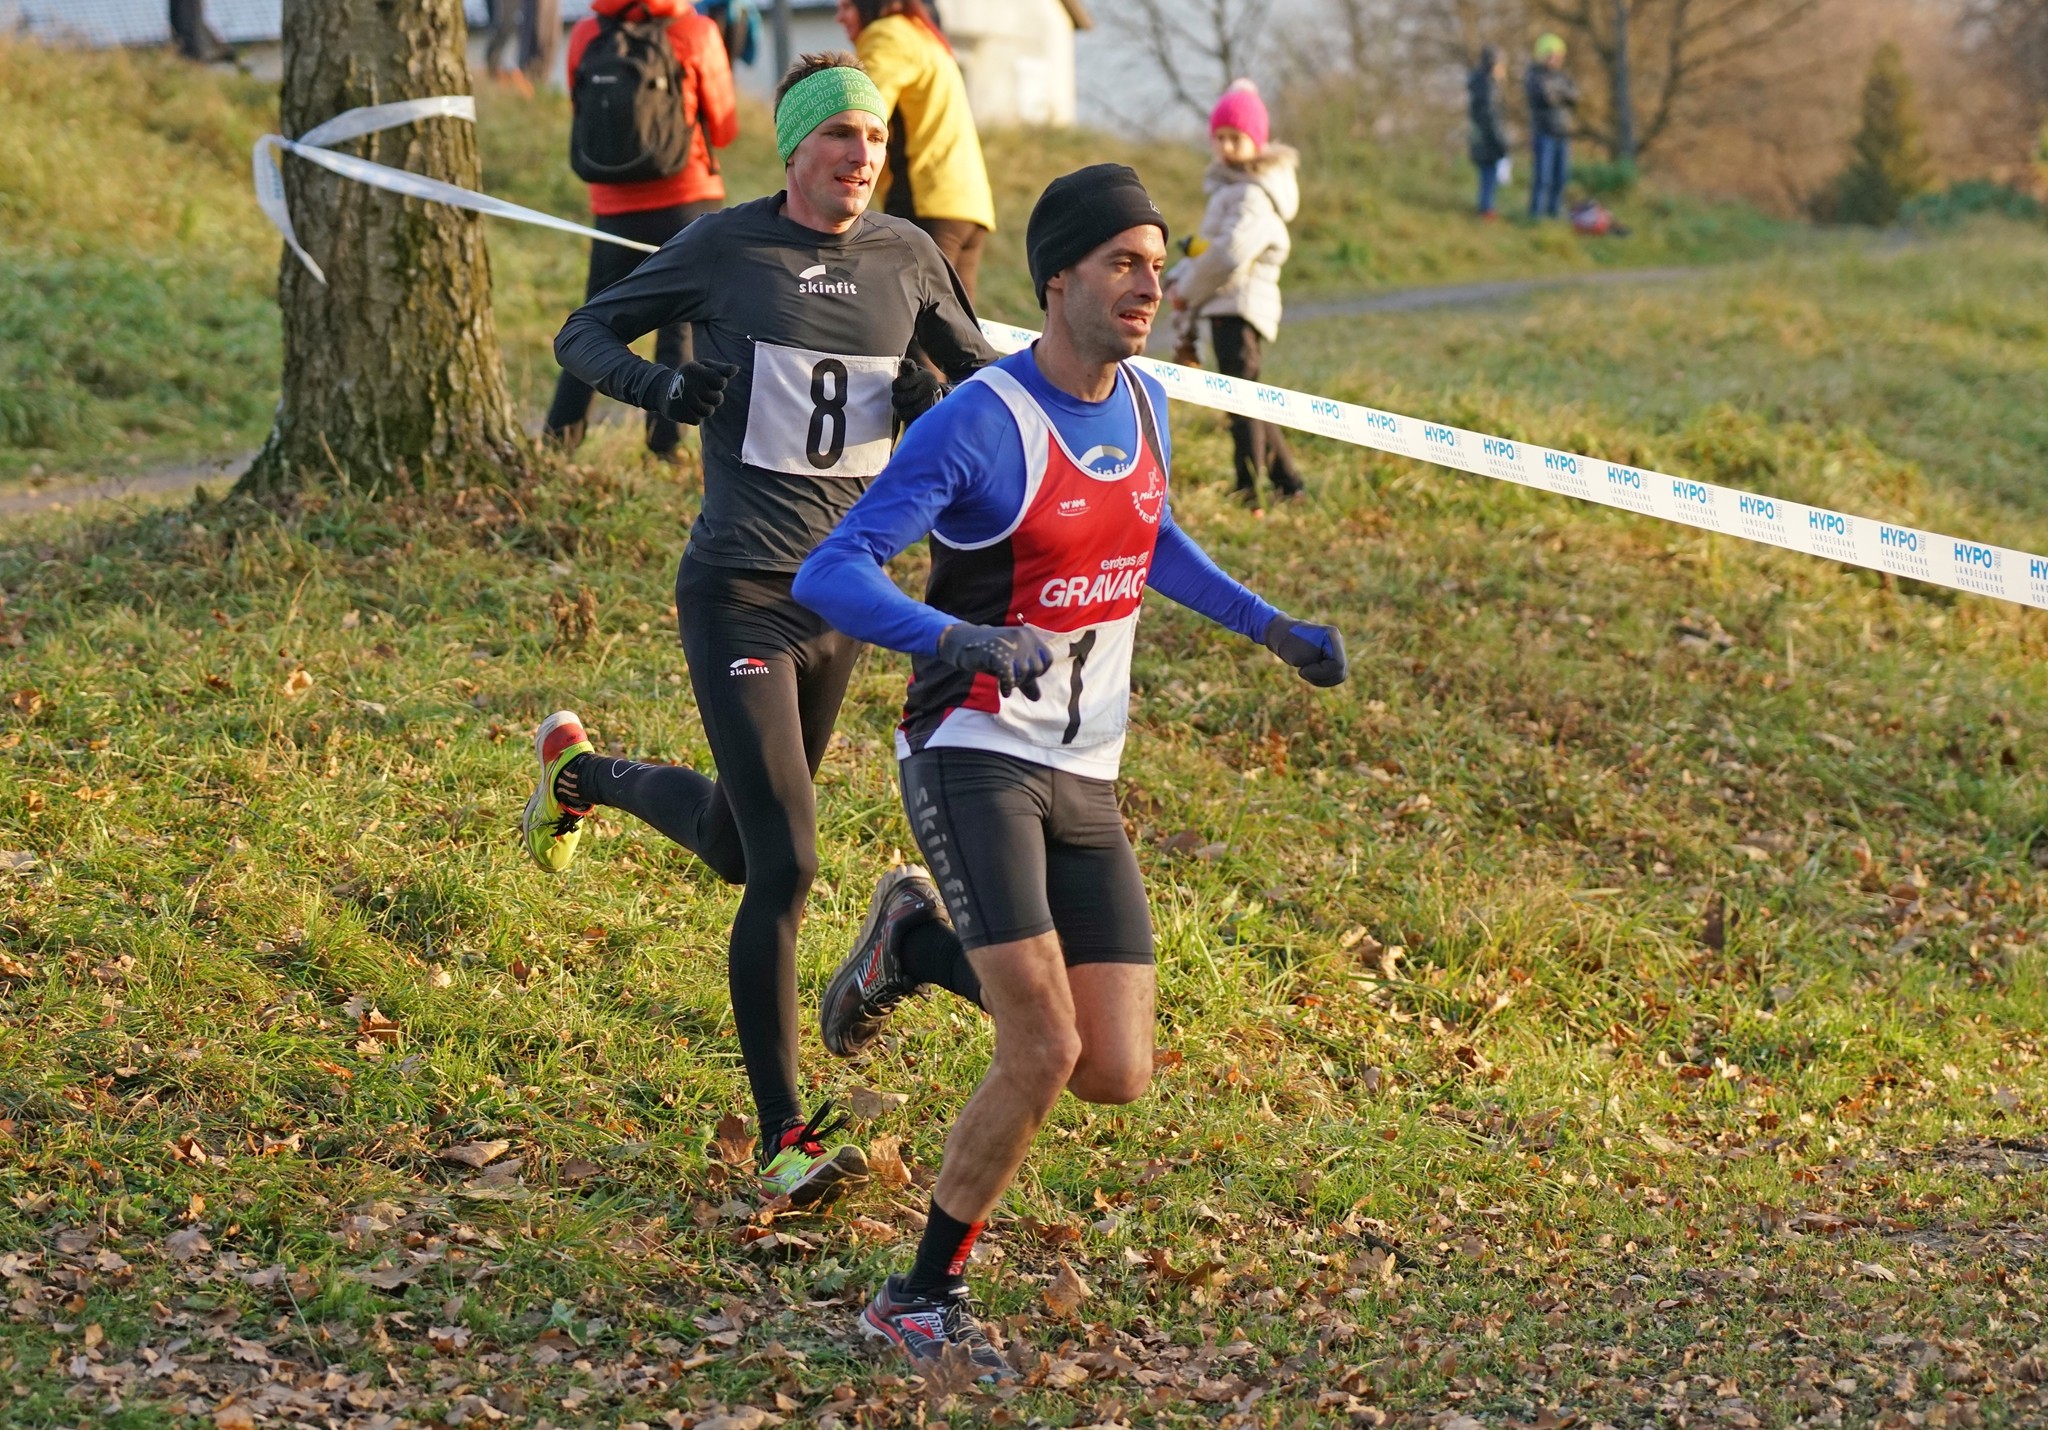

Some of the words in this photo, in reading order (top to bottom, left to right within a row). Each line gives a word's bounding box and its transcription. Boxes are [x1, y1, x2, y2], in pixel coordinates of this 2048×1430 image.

[799, 280, 858, 295] skinfit
[1205, 374, 1232, 394] HYPO
[1257, 386, 1285, 407] HYPO
[806, 358, 848, 470] 8
[1311, 398, 1340, 419] HYPO
[1366, 411, 1397, 433] HYPO
[1424, 425, 1455, 447] HYPO
[1483, 438, 1515, 461] HYPO
[1544, 451, 1577, 475] HYPO
[1607, 465, 1641, 489] HYPO
[1672, 480, 1707, 504] HYPO
[1739, 495, 1775, 520] HYPO
[1809, 510, 1845, 535] HYPO
[1880, 526, 1918, 552] HYPO
[1100, 555, 1137, 570] erdgas
[1881, 548, 1929, 567] LANDESBANK
[1954, 542, 1993, 569] HYPO
[1883, 558, 1931, 579] VORARLBERG
[1955, 565, 2004, 584] LANDESBANK
[2030, 558, 2048, 580] HY
[1957, 576, 2006, 596] VORARLBERG
[730, 666, 770, 676] skinfit
[1061, 629, 1097, 744] 1
[913, 786, 973, 928] skinfit
